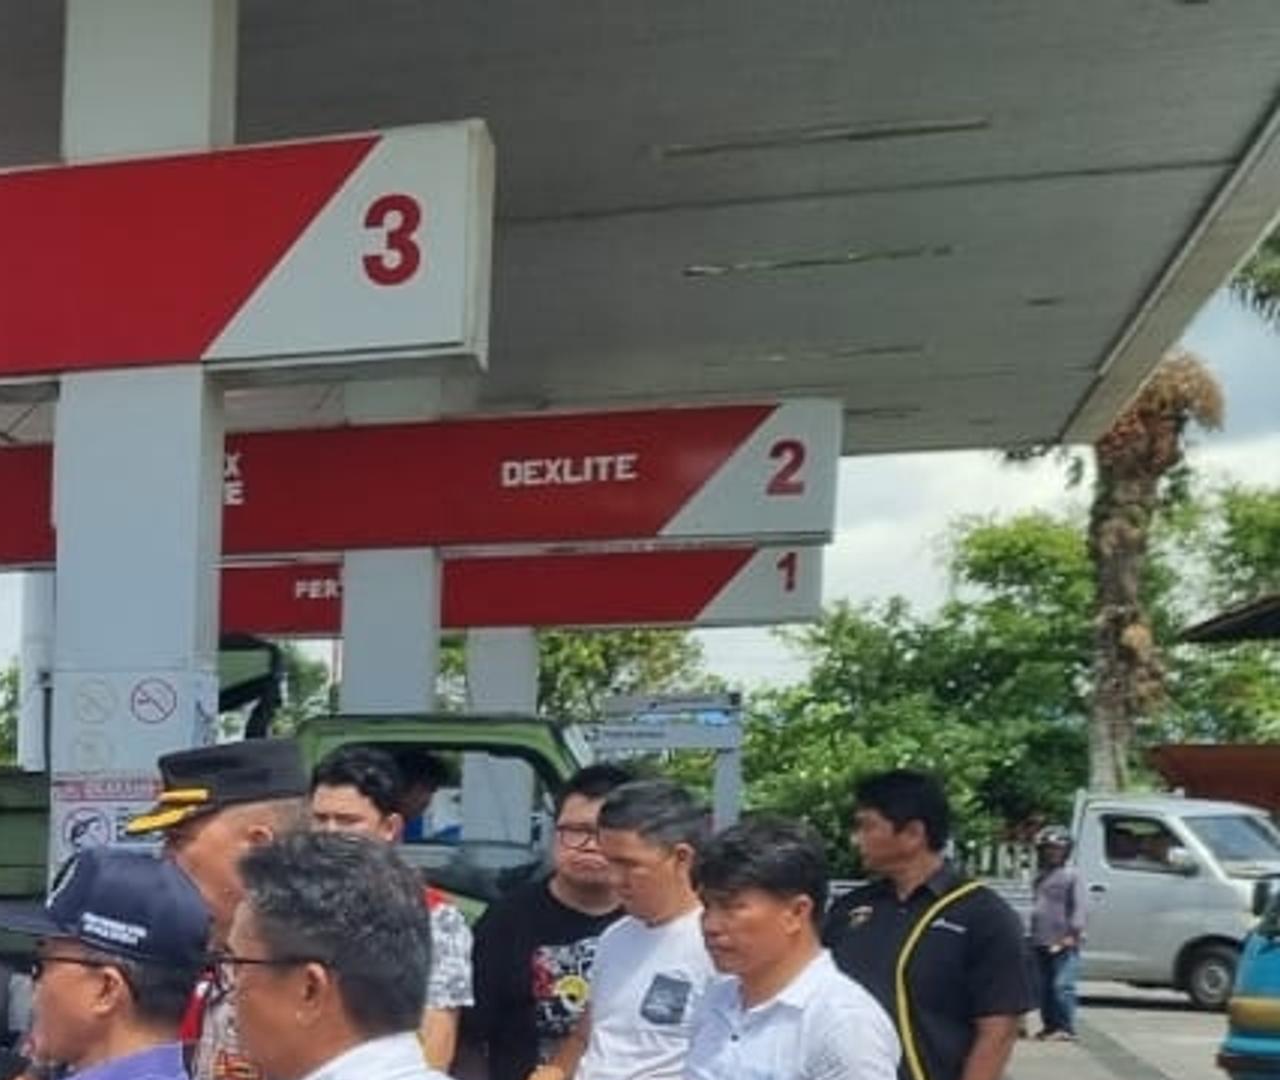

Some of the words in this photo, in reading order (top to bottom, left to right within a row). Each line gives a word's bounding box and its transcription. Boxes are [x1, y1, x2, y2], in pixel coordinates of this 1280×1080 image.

[362, 193, 421, 287] 3
[501, 453, 638, 488] DEXLITE
[766, 439, 807, 496] 2
[776, 551, 798, 590] 1
